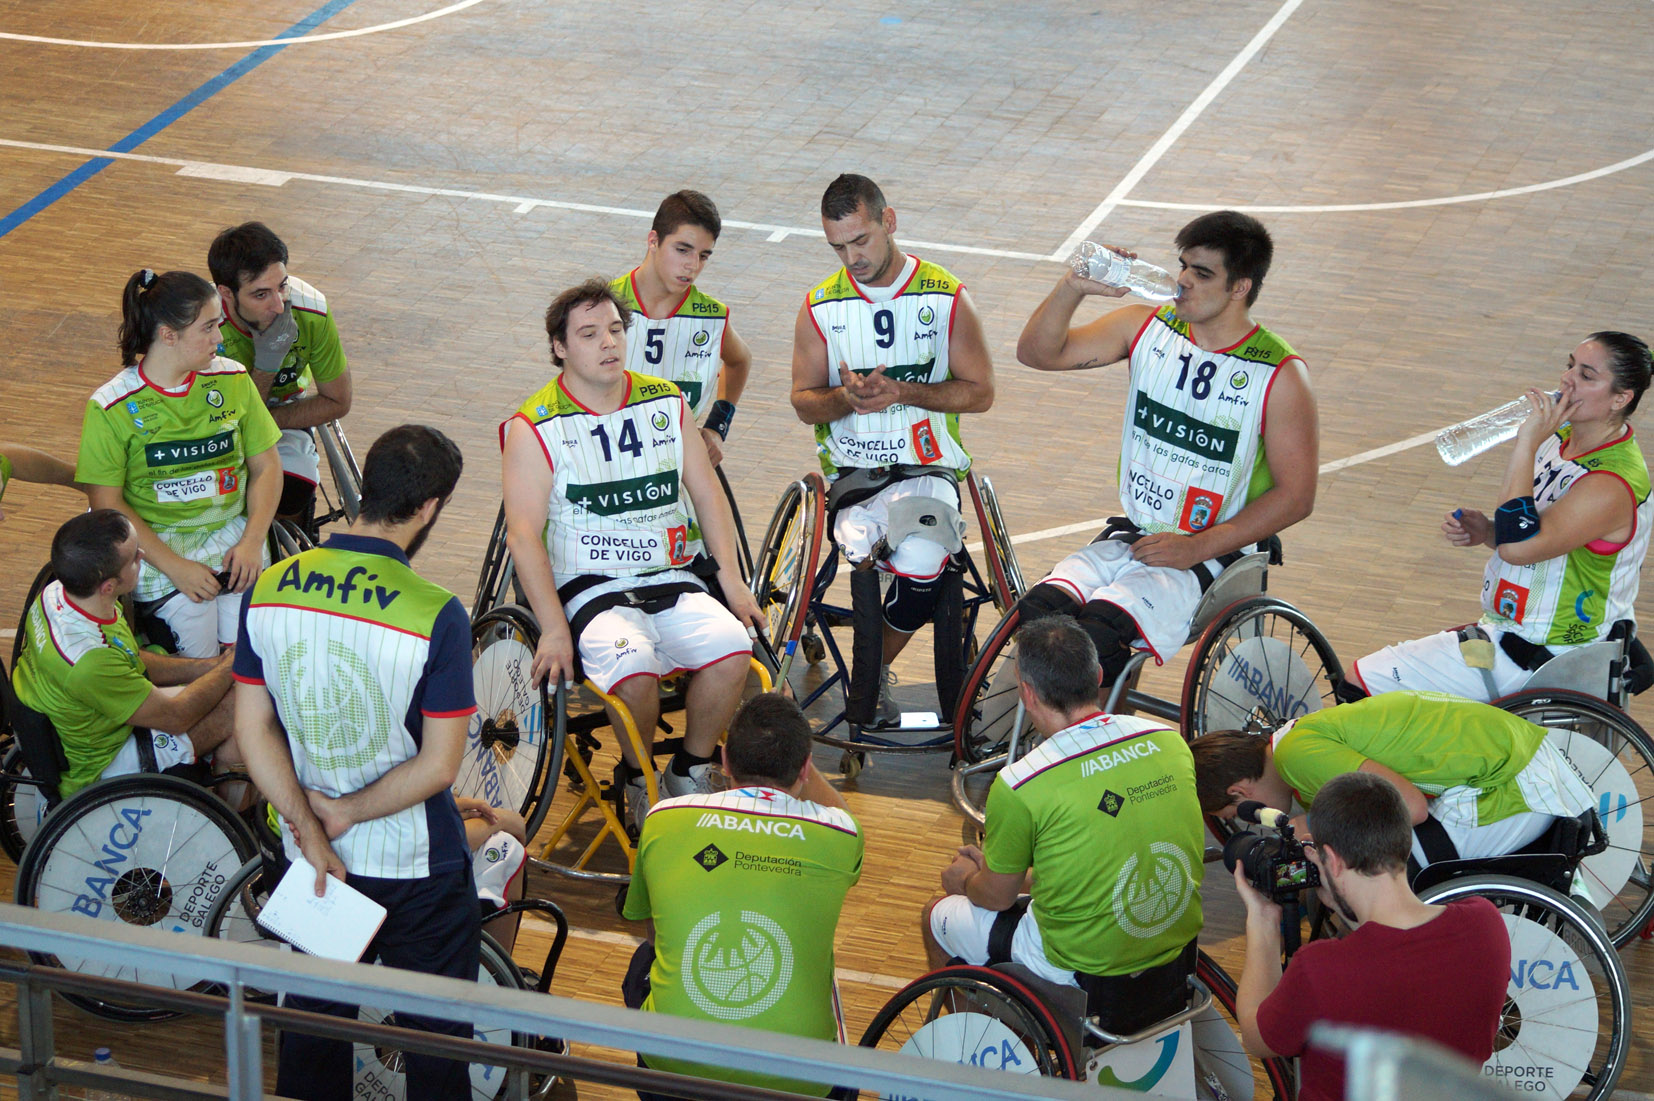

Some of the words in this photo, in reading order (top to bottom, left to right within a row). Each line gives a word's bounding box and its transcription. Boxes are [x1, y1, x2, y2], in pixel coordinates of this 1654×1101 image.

[692, 303, 719, 313] PB15
[873, 309, 895, 349] 9
[645, 329, 666, 364] 5
[685, 350, 712, 359] Amfiv
[1175, 352, 1217, 400] 18
[639, 382, 671, 397] PB15
[1218, 391, 1249, 407] Amfiv
[209, 409, 236, 424] Amfiv
[591, 418, 643, 462] 14
[1152, 414, 1225, 452] VISIÓN
[171, 440, 229, 458] VISIÓN
[840, 436, 906, 451] CONCELLO
[866, 453, 899, 464] VIGO
[1153, 444, 1168, 457] las
[1171, 452, 1200, 468] gafas
[1202, 464, 1230, 477] caras
[157, 475, 213, 490] CONCELLO
[166, 487, 179, 498] DE
[181, 484, 207, 496] VIGO
[599, 482, 672, 508] VISIÓN
[1135, 488, 1162, 511] VIGO
[580, 535, 658, 549] CONCELLO
[590, 549, 609, 561] DE
[615, 549, 652, 562] VIGO
[277, 558, 401, 610] Amfiv
[1126, 774, 1175, 796] Deputación
[1129, 783, 1178, 806] Pontevedra
[734, 859, 802, 877] Pontevedra
[735, 851, 802, 867] Deputación
[179, 861, 218, 923] DEPORTE
[192, 874, 226, 928] GALEGO
[1485, 1065, 1554, 1078] DEPORTE
